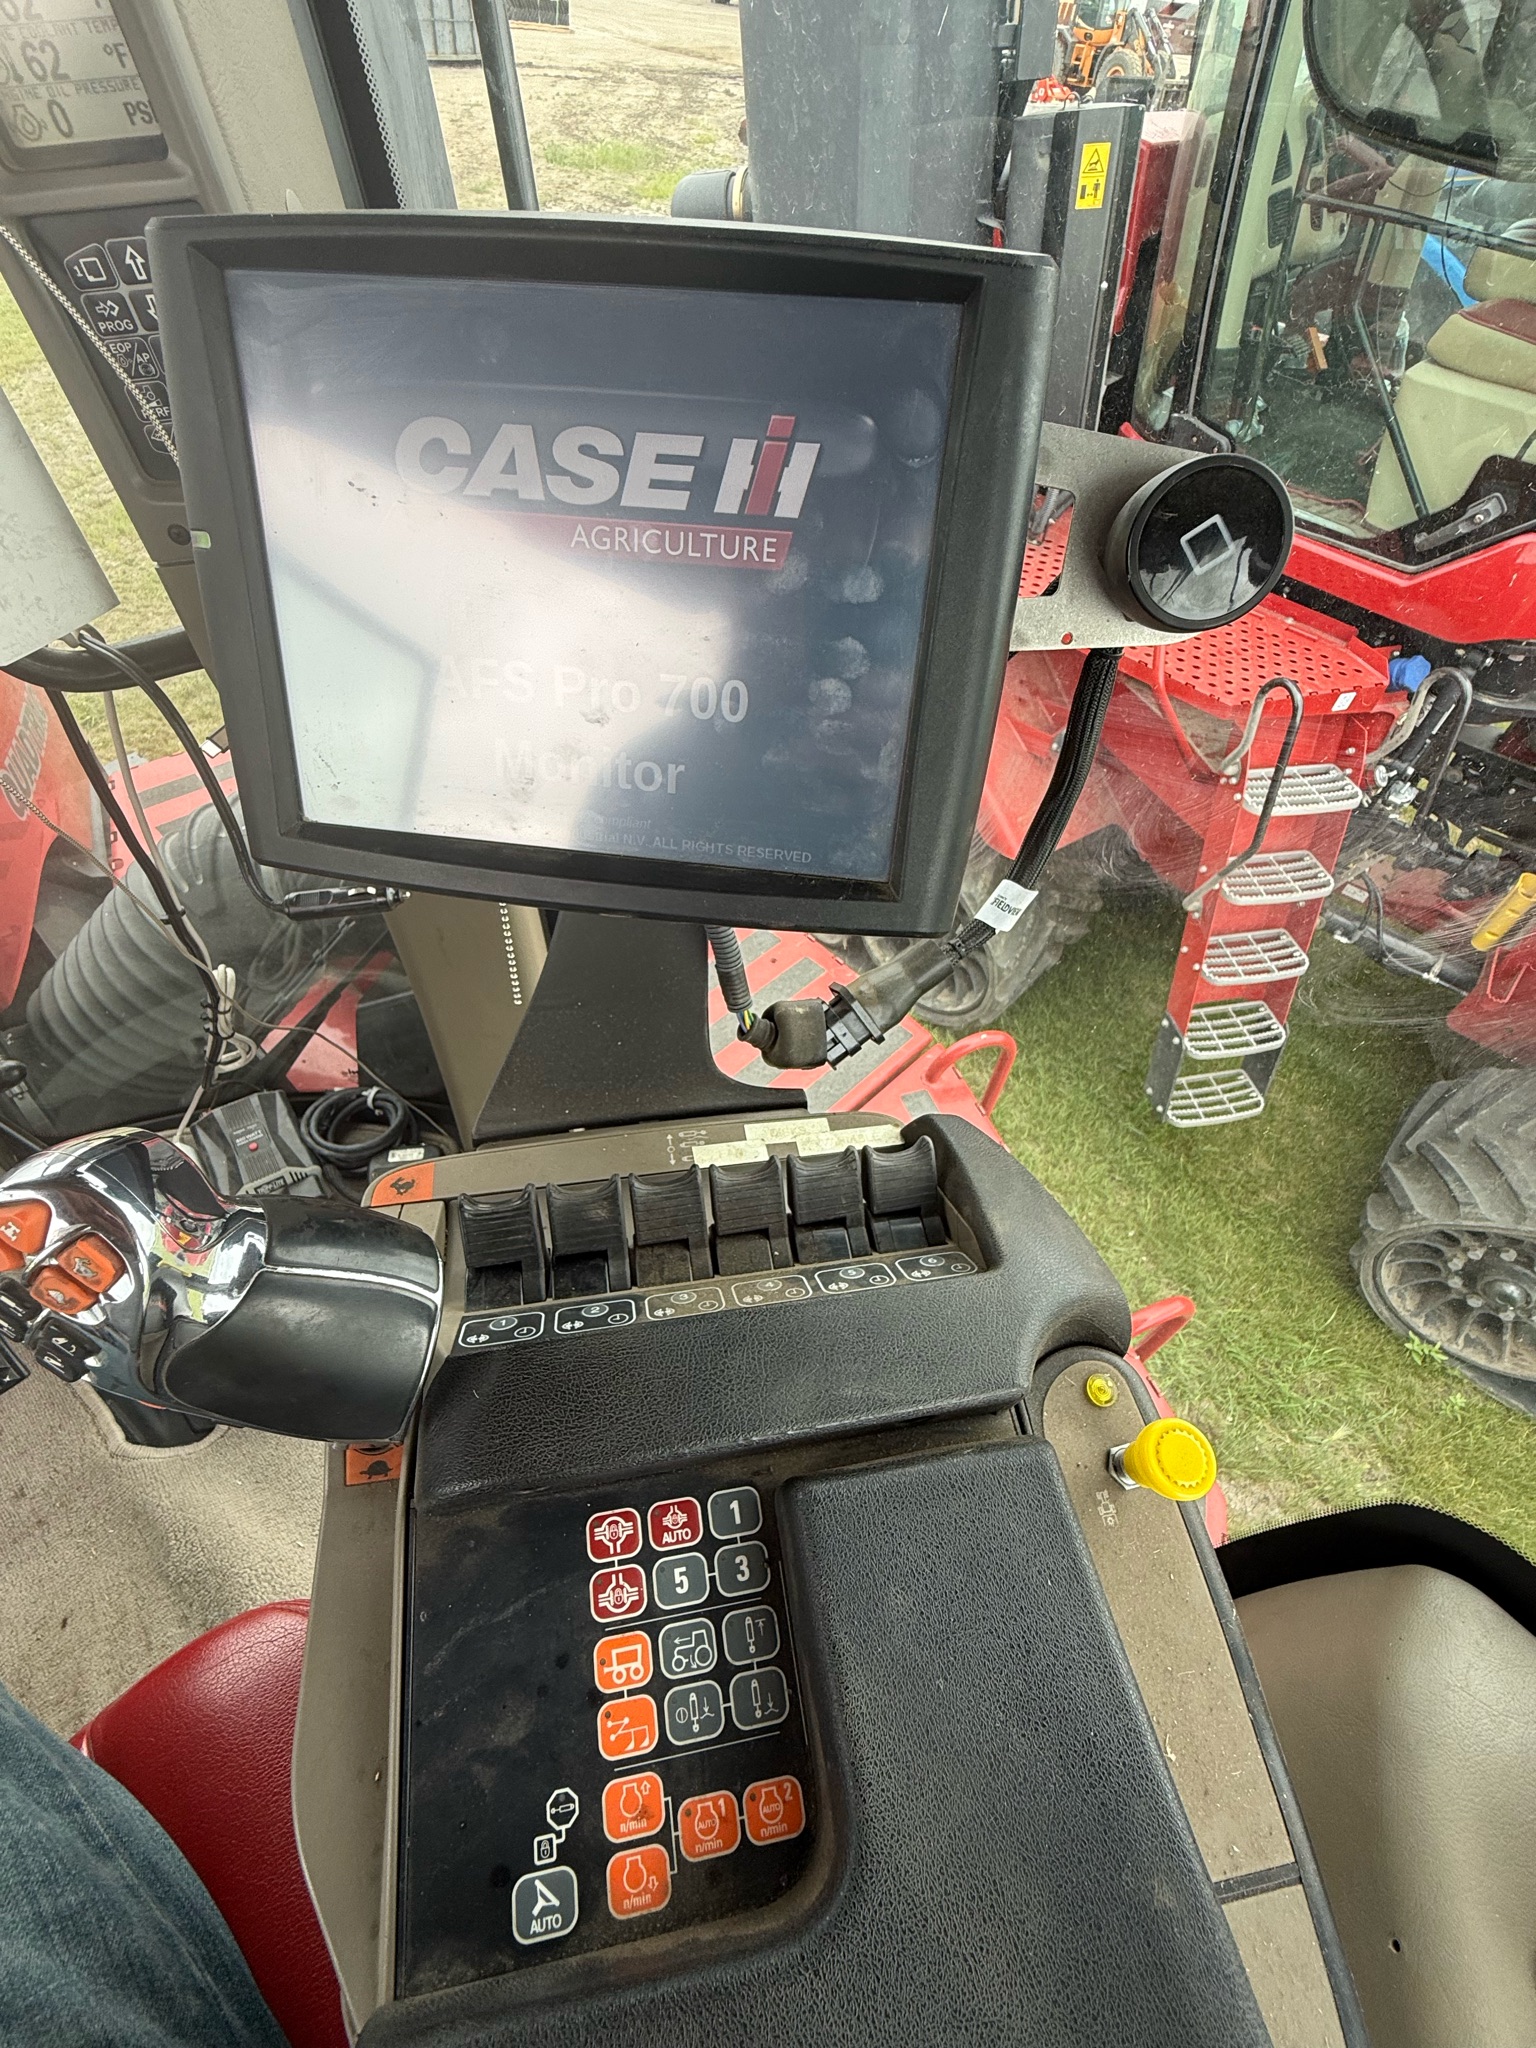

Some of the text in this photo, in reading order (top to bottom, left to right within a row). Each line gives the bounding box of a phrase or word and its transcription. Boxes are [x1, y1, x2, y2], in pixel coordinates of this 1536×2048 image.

[20, 39, 71, 82] 62
[47, 84, 71, 98] OIL
[74, 77, 142, 95] PRESSURE
[47, 99, 74, 138] 0
[98, 319, 134, 333] PROG
[109, 342, 132, 354] EOP
[136, 353, 150, 364] AP
[141, 405, 170, 418] PRF
[395, 416, 705, 509] CASE
[570, 523, 778, 564] AGRICULTURE
[436, 654, 750, 723] AFS Pro 700
[500, 735, 686, 794] Monitor
[653, 836, 679, 851] ALL
[681, 838, 735, 856] RIGHTS
[737, 844, 813, 865] RESERVED
[729, 1500, 741, 1525] 1
[661, 1527, 692, 1545] AUTO
[734, 1555, 750, 1582] 3
[673, 1566, 689, 1595] 5
[784, 1782, 794, 1801] 2
[717, 1797, 726, 1817] 1
[762, 1802, 781, 1814] AUTO
[619, 1819, 648, 1834] n/min
[698, 1819, 718, 1830] AUTO
[760, 1822, 788, 1838] n/min
[695, 1839, 723, 1854] n/min
[623, 1893, 652, 1910] n/min
[530, 1913, 563, 1936] AUTO
